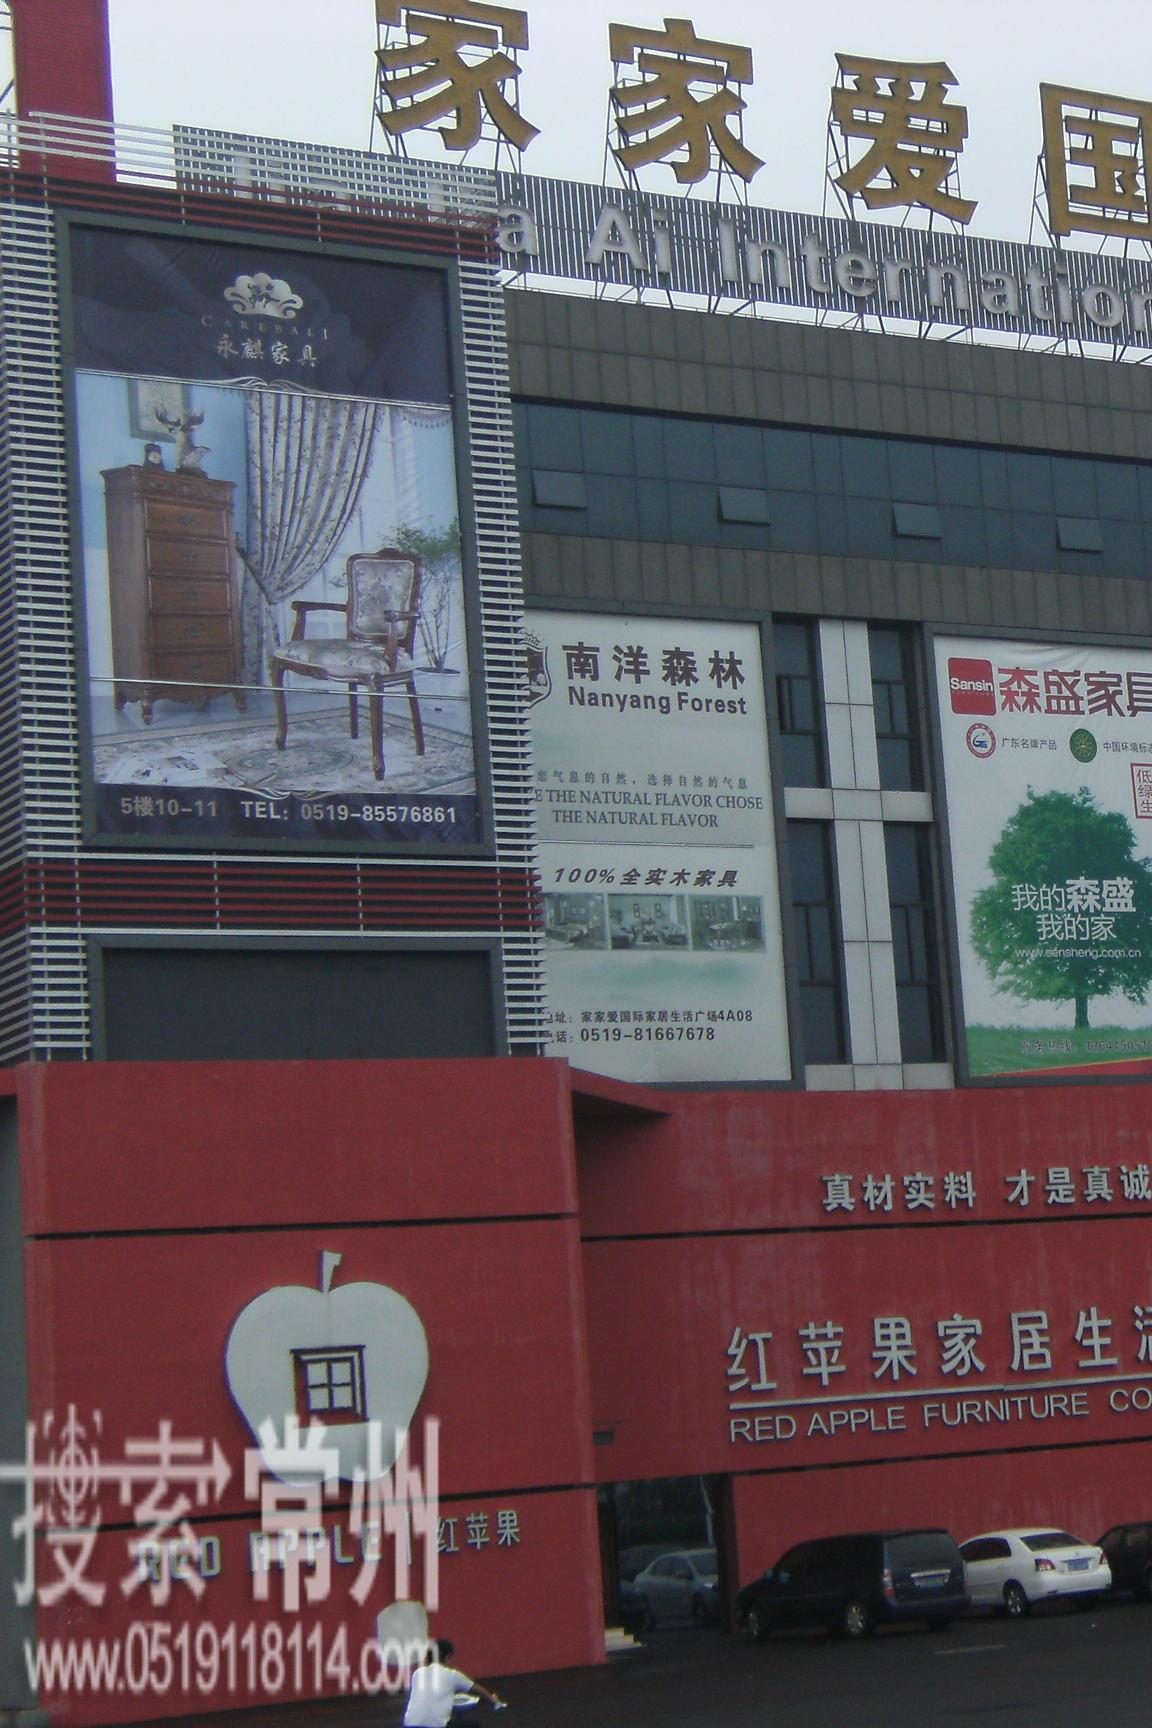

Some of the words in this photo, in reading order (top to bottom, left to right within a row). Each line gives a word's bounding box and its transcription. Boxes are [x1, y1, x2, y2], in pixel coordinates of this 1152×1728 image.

[586, 202, 672, 275] Ai
[562, 641, 746, 690] 南洋森林
[950, 677, 994, 692] Sansin
[568, 685, 671, 714] Nanyang
[677, 691, 747, 715] Forest
[120, 797, 218, 817] 5楼10-11
[546, 789, 577, 803] THE
[580, 791, 651, 806] NATURAL
[655, 793, 712, 808] FLAVOR
[715, 795, 764, 810] CHOSE
[301, 803, 456, 824] 0519-85576861
[552, 809, 582, 824] THE
[586, 810, 657, 826] NATURAL
[661, 812, 719, 828] FLAVOR
[554, 867, 738, 888] 100%全实木家具
[1011, 876, 1137, 913] 我的森盛
[1036, 914, 1117, 941] 我的家
[581, 1028, 715, 1042] 0519-81667678
[821, 1172, 978, 1213] 真材实料
[729, 1414, 798, 1444] RED
[807, 1405, 907, 1437] APPLE
[923, 1391, 1091, 1427] FURNITURE
[435, 1509, 521, 1554] 红苹果
